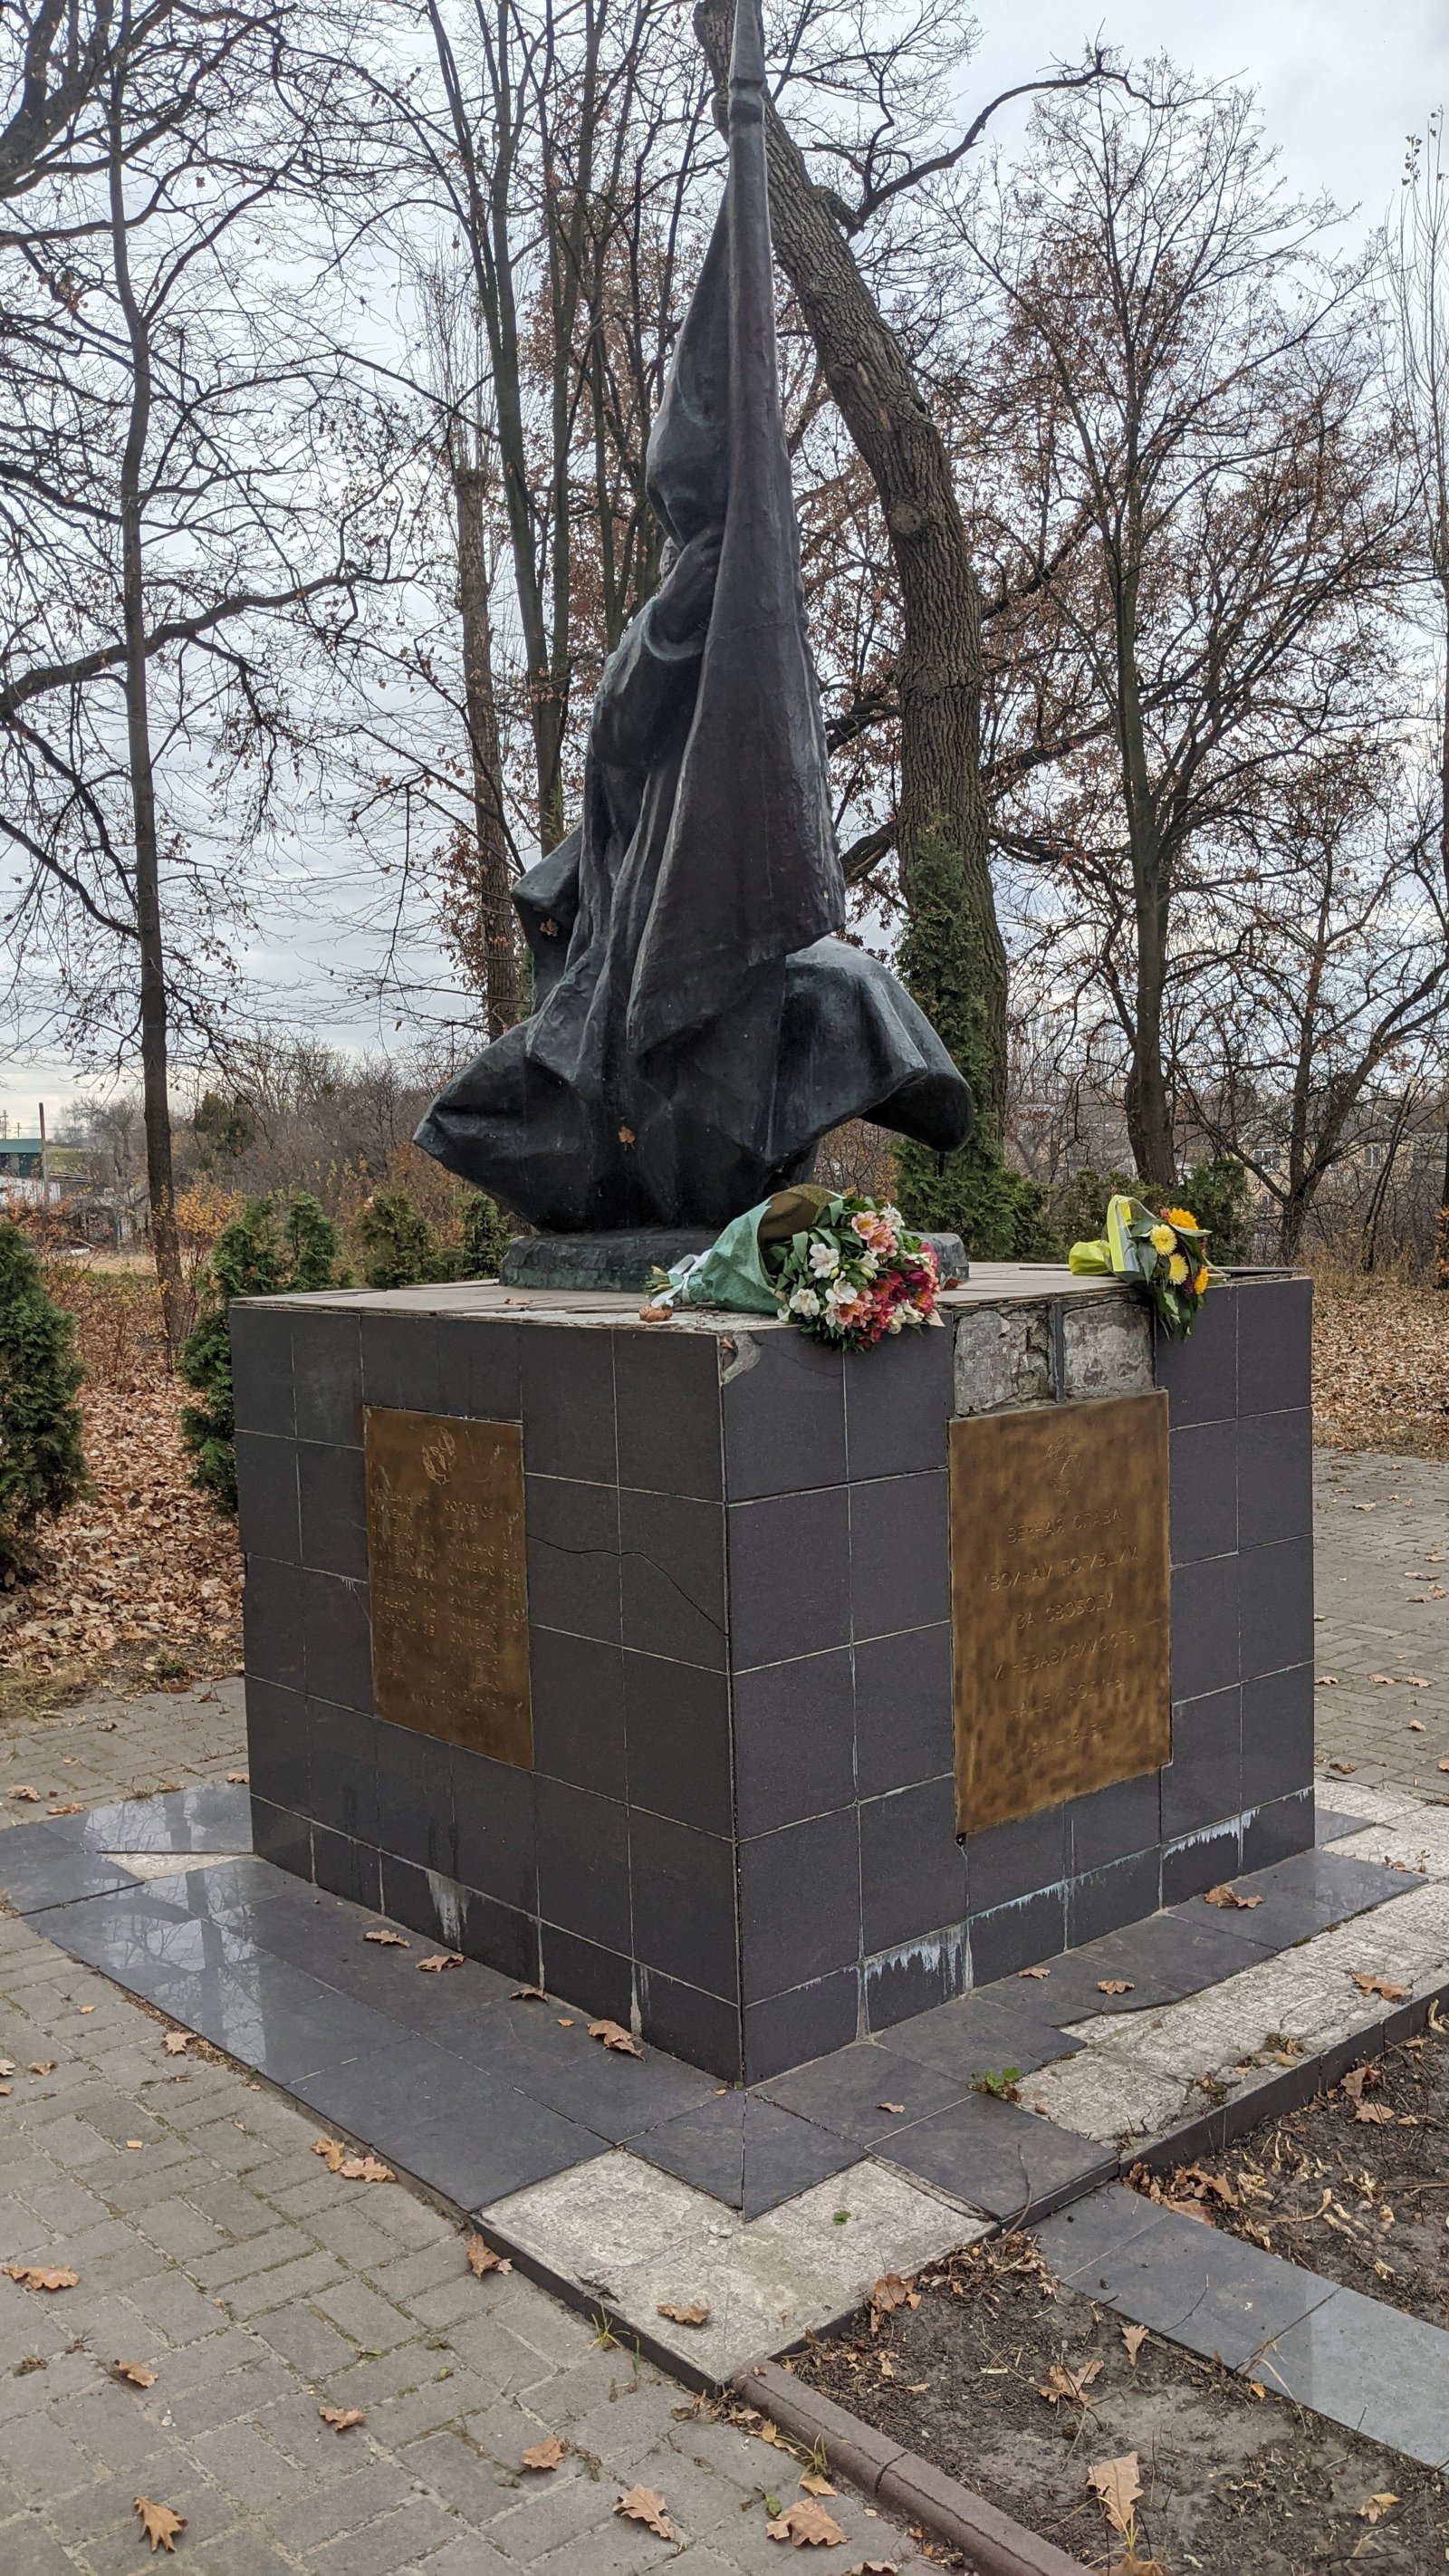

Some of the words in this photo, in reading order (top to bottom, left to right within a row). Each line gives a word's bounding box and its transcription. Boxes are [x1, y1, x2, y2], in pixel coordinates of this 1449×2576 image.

[1007, 1518, 1065, 1543] ВЕЧНАЯ
[1072, 1507, 1122, 1530] СЛАВА
[991, 1564, 1052, 1591] ВОИНАМ
[1060, 1545, 1138, 1578] ПОГИБШИМ
[1016, 1610, 1036, 1629] ЗА
[1045, 1591, 1114, 1622] СВОБОДУ
[1012, 1629, 1137, 1676] НЕЗАВИСИМОСТЬ
